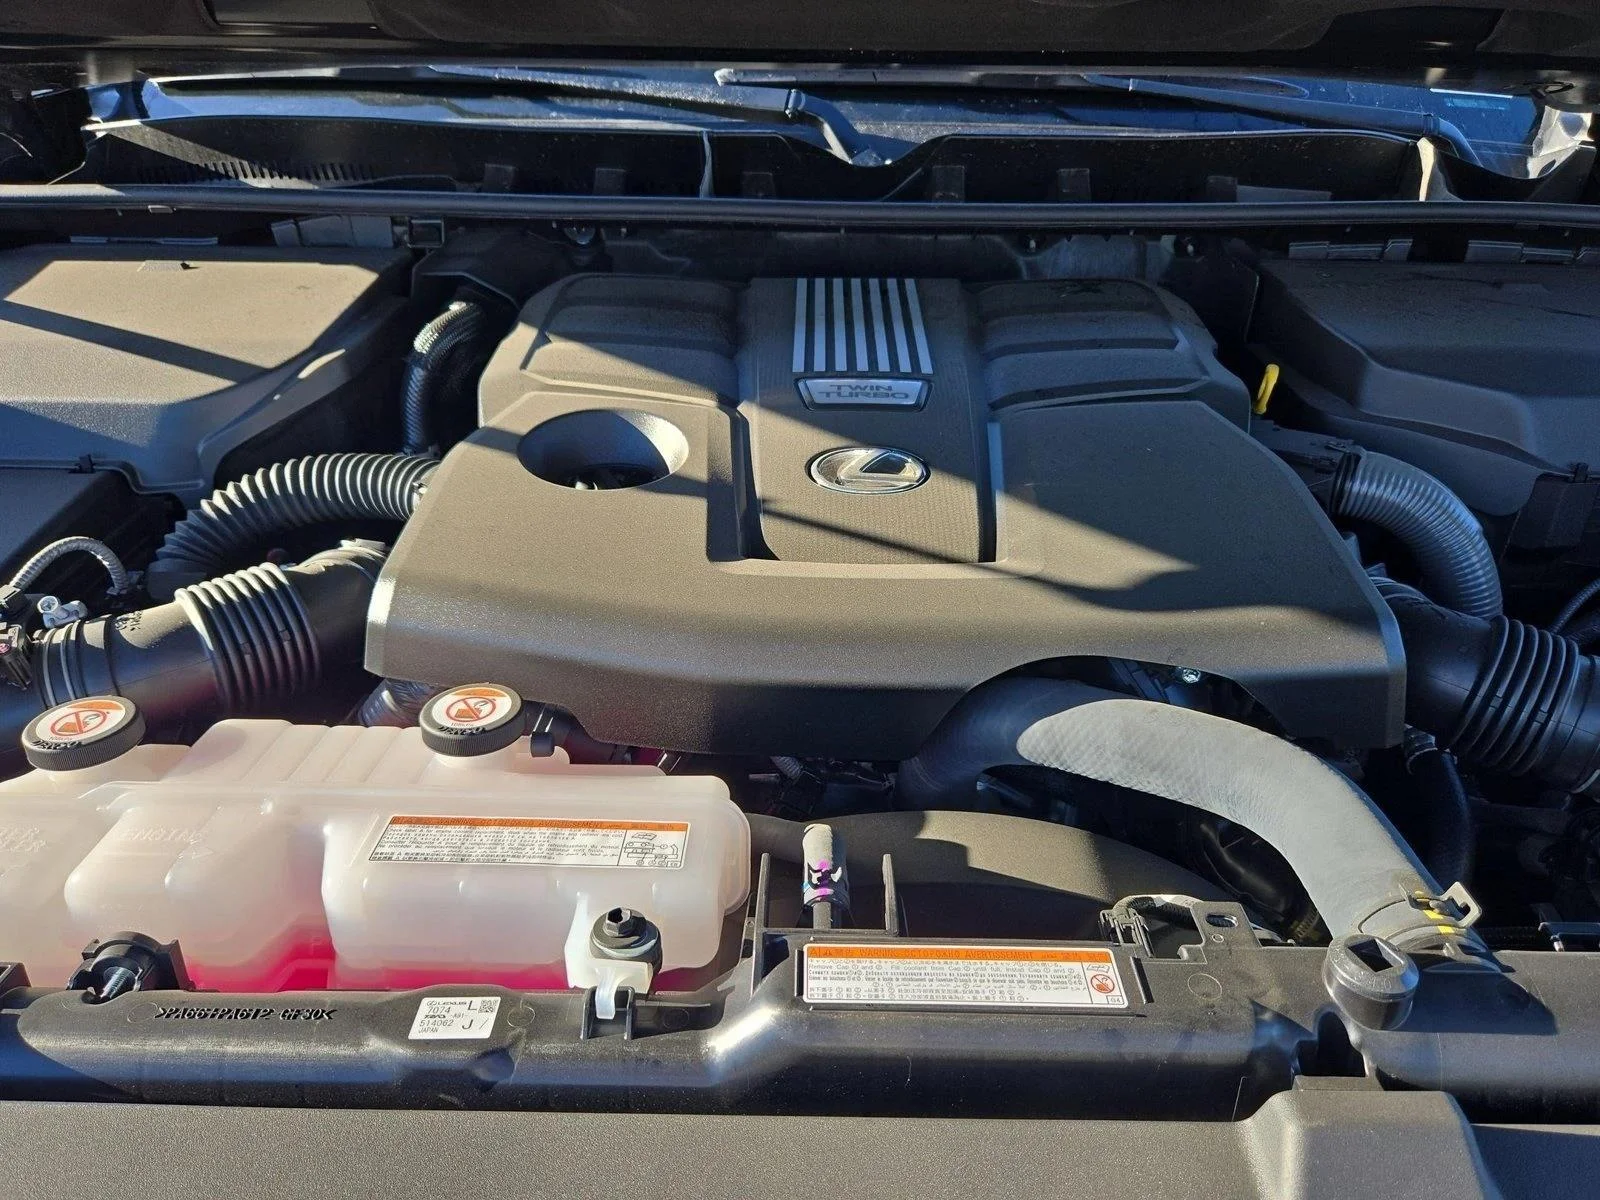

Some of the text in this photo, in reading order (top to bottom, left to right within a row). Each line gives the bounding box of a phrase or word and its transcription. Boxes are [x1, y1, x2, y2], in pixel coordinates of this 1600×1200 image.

[818, 391, 909, 399] TURBO
[964, 950, 1032, 959] AVERTISSEMENT
[468, 1000, 477, 1010] L
[428, 1006, 450, 1014] 7074
[462, 1019, 474, 1030] J
